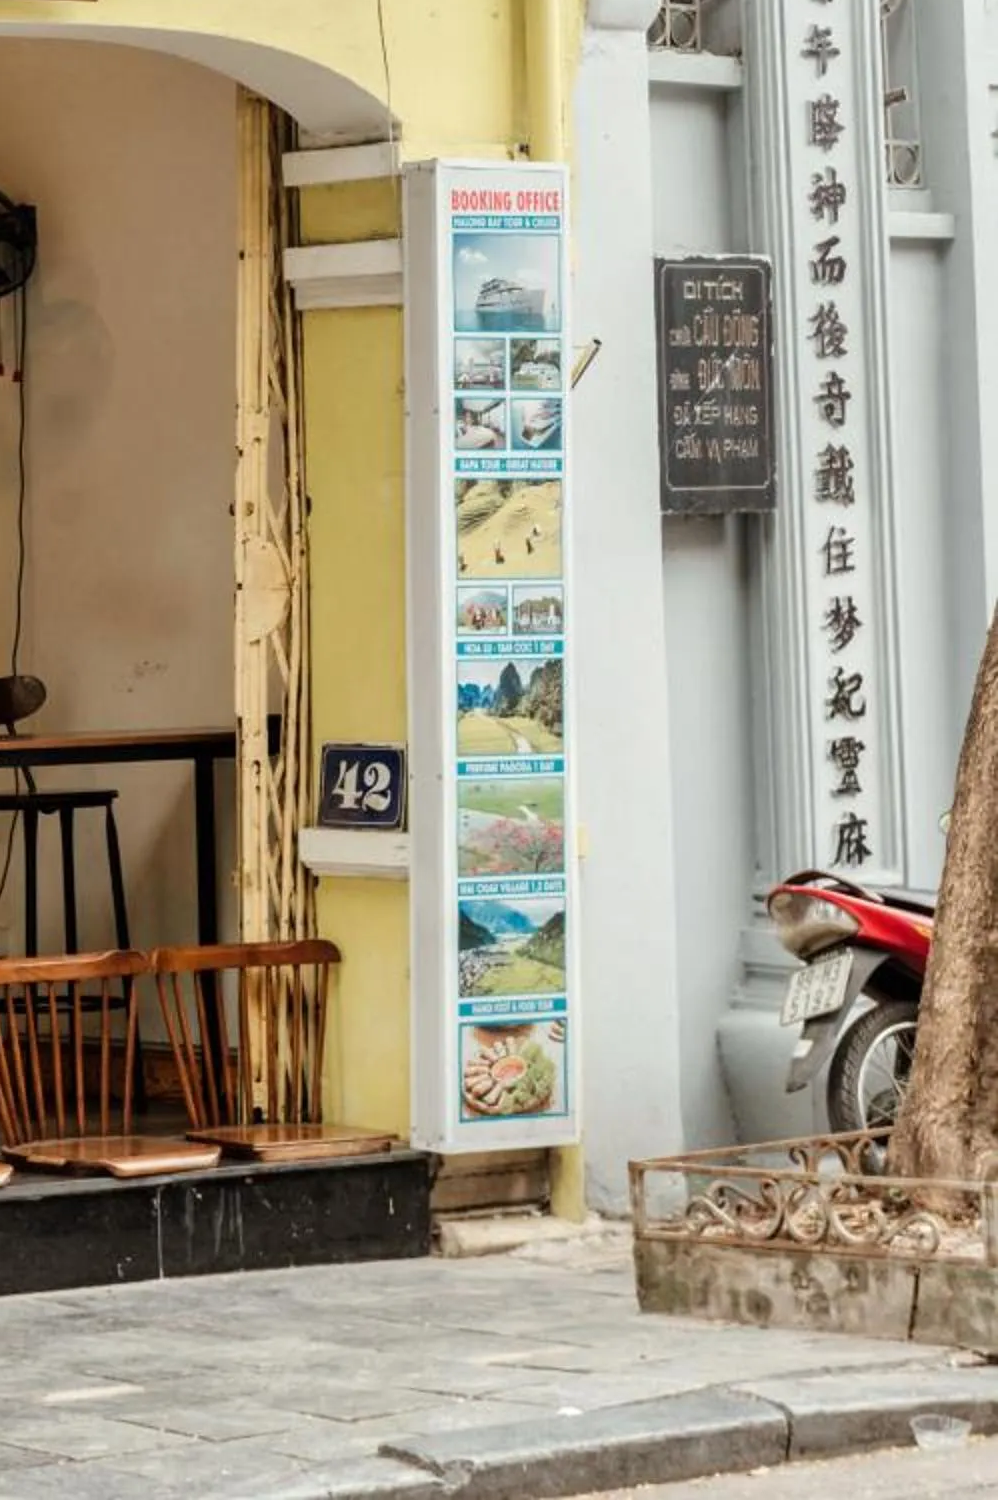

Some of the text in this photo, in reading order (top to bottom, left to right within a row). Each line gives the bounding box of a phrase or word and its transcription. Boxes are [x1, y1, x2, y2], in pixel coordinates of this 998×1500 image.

[451, 190, 559, 212] BOOKING OFFICE
[331, 759, 391, 812] 42
